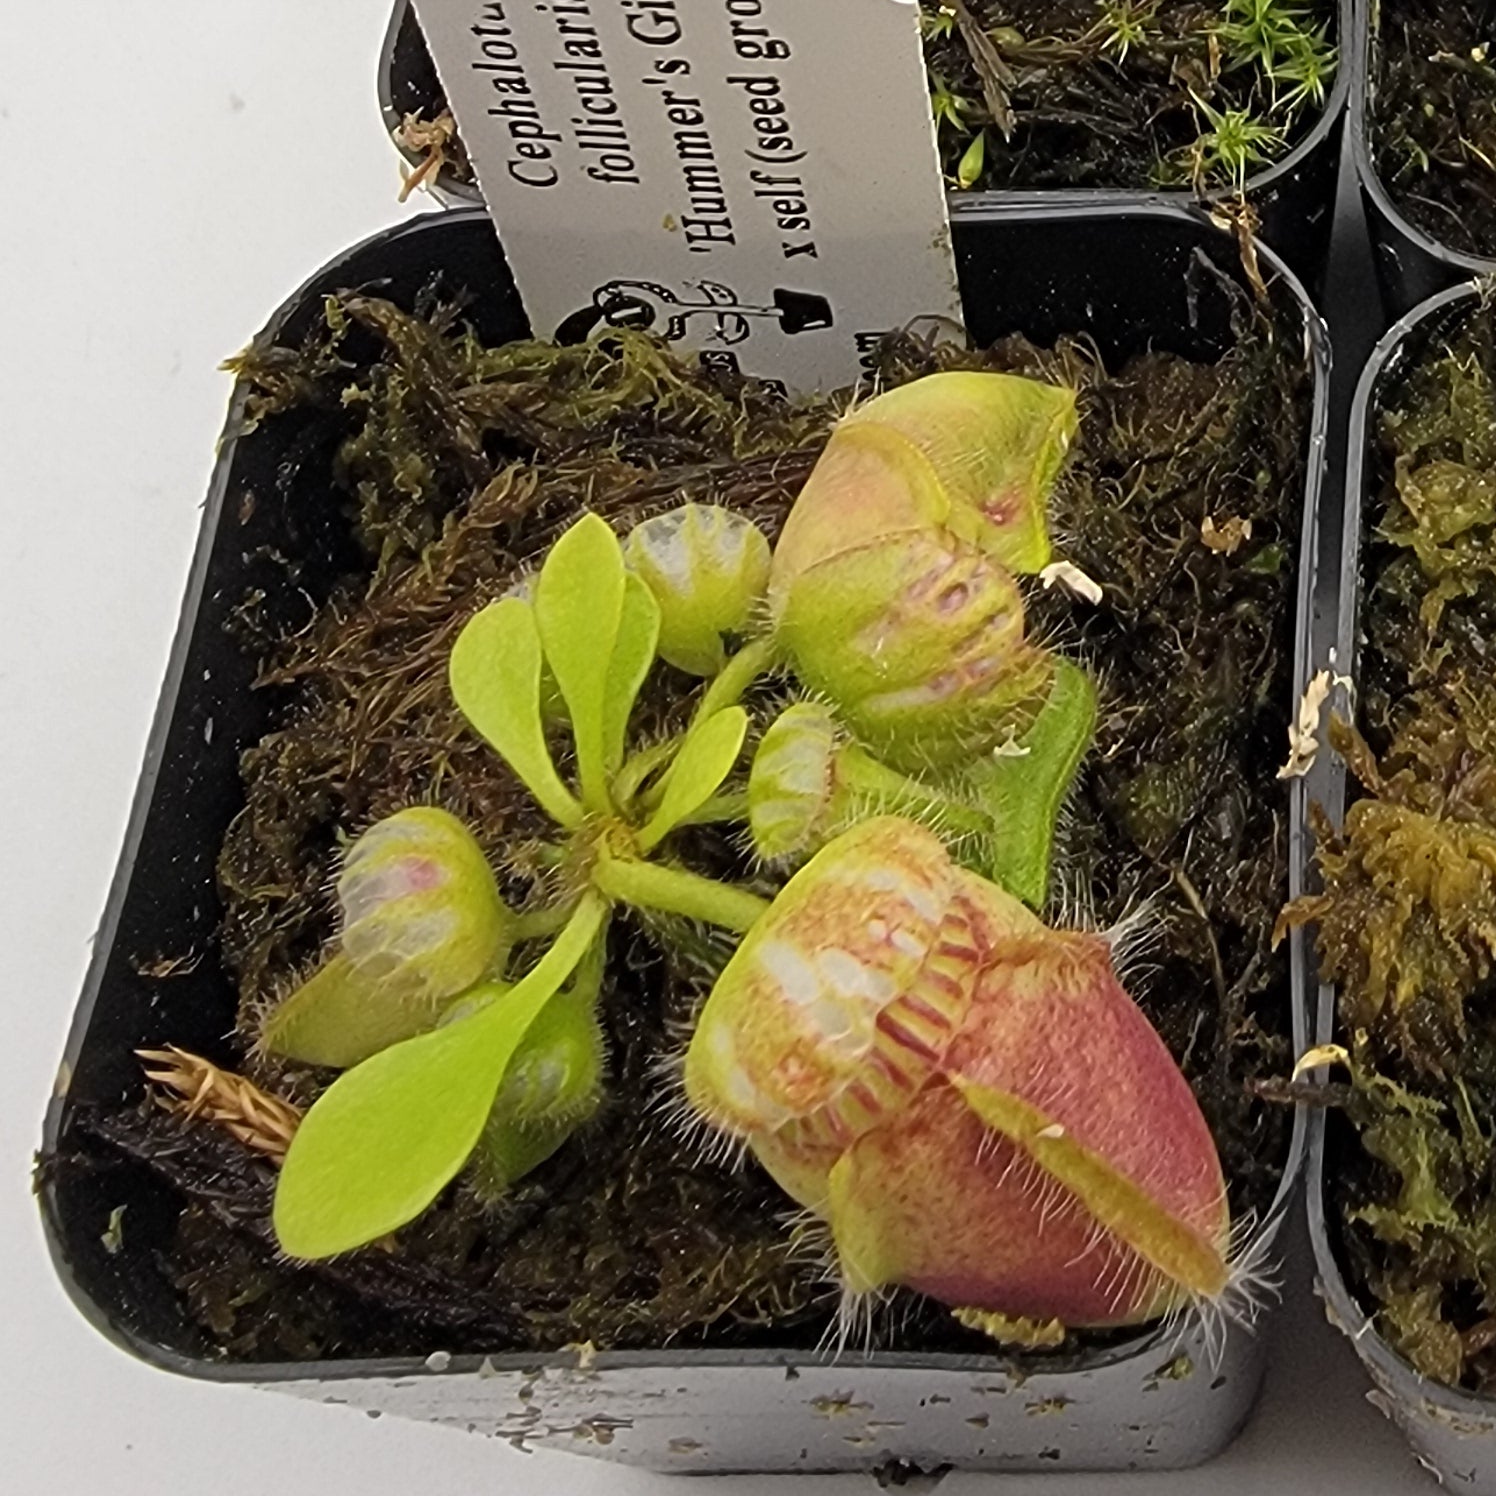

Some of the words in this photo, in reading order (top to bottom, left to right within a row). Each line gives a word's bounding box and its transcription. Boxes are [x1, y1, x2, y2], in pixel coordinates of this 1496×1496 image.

[642, 59, 737, 252] 'Hummer's
[727, 75, 808, 164] (seed
[749, 170, 811, 232] self
[783, 241, 817, 259] x
